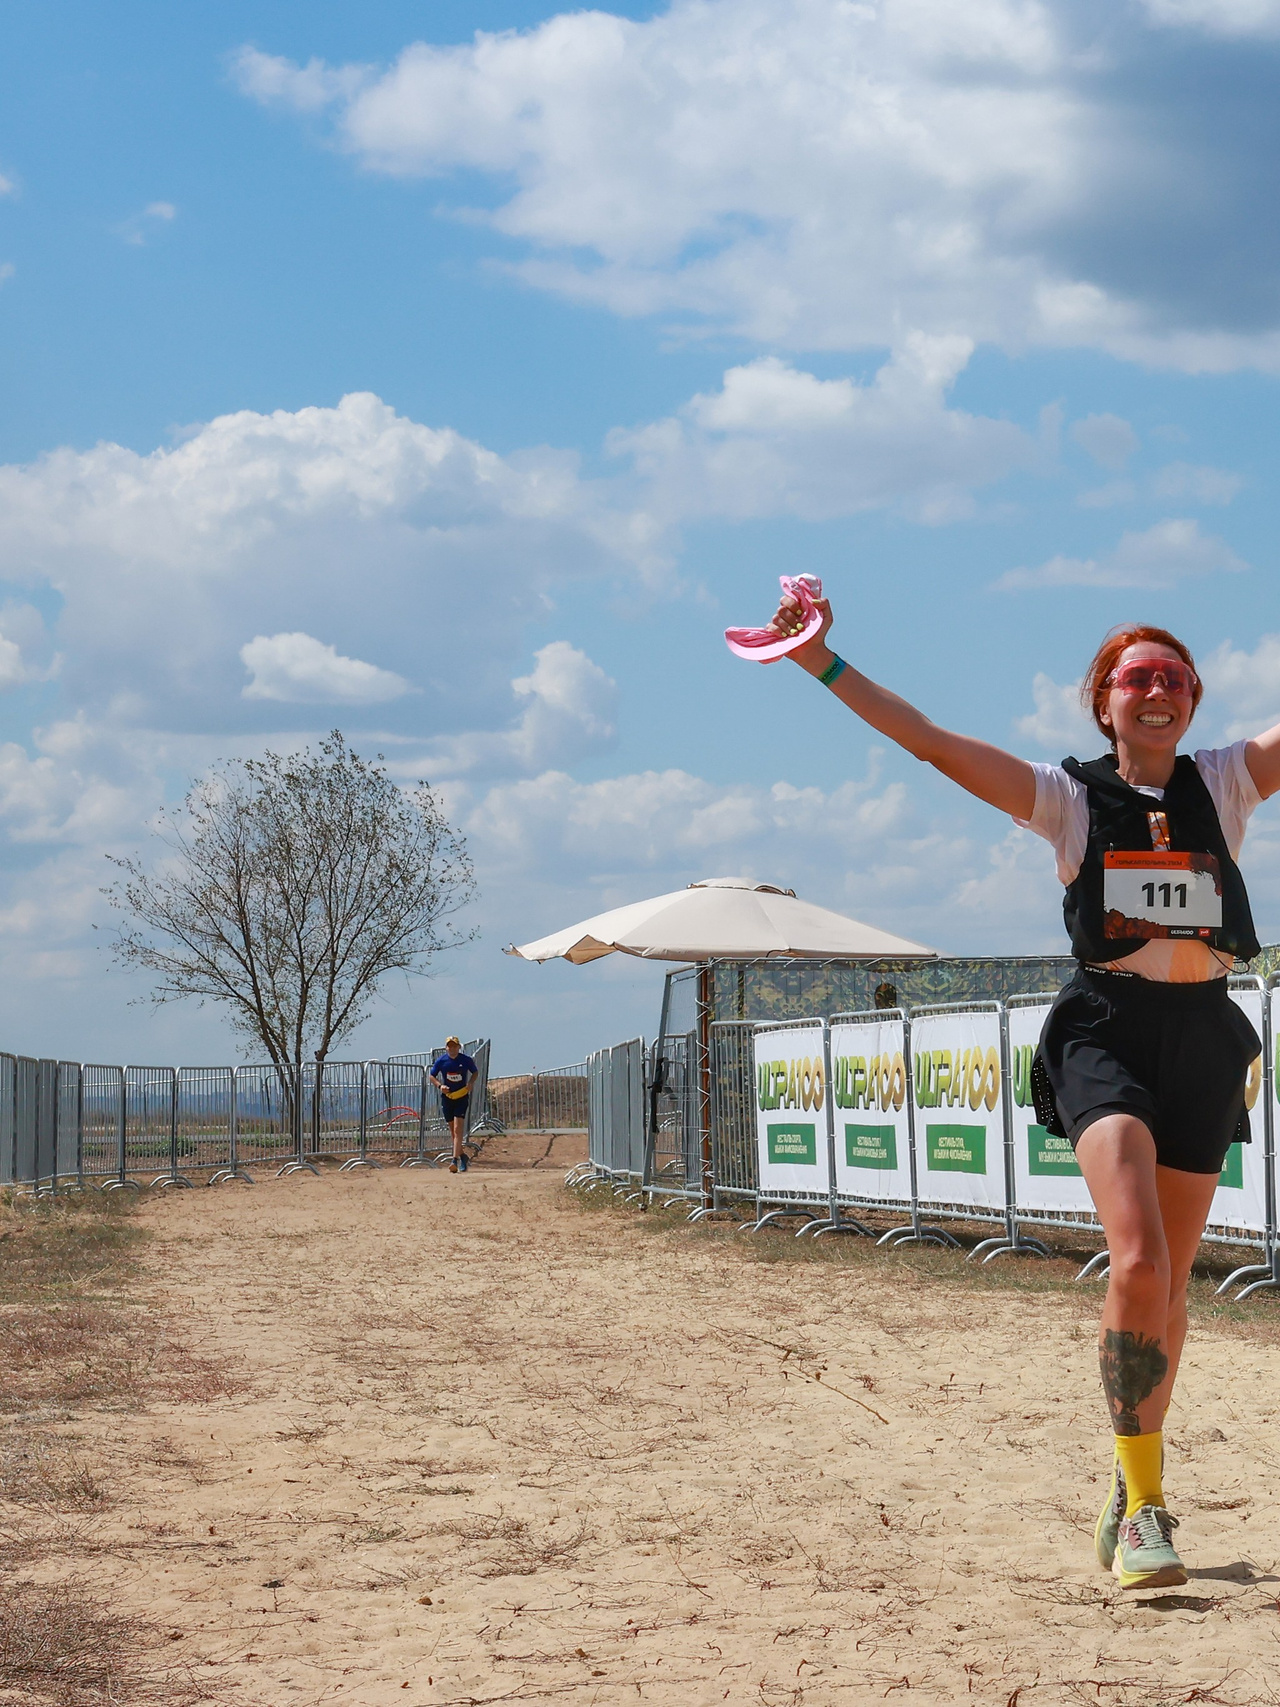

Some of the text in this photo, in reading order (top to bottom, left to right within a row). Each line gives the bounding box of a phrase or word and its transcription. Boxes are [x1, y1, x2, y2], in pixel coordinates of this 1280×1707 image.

[1142, 882, 1187, 908] 111
[757, 1055, 825, 1112] ULTRA100
[833, 1051, 906, 1113] ULTRA100
[914, 1045, 1000, 1112] ULTRA100
